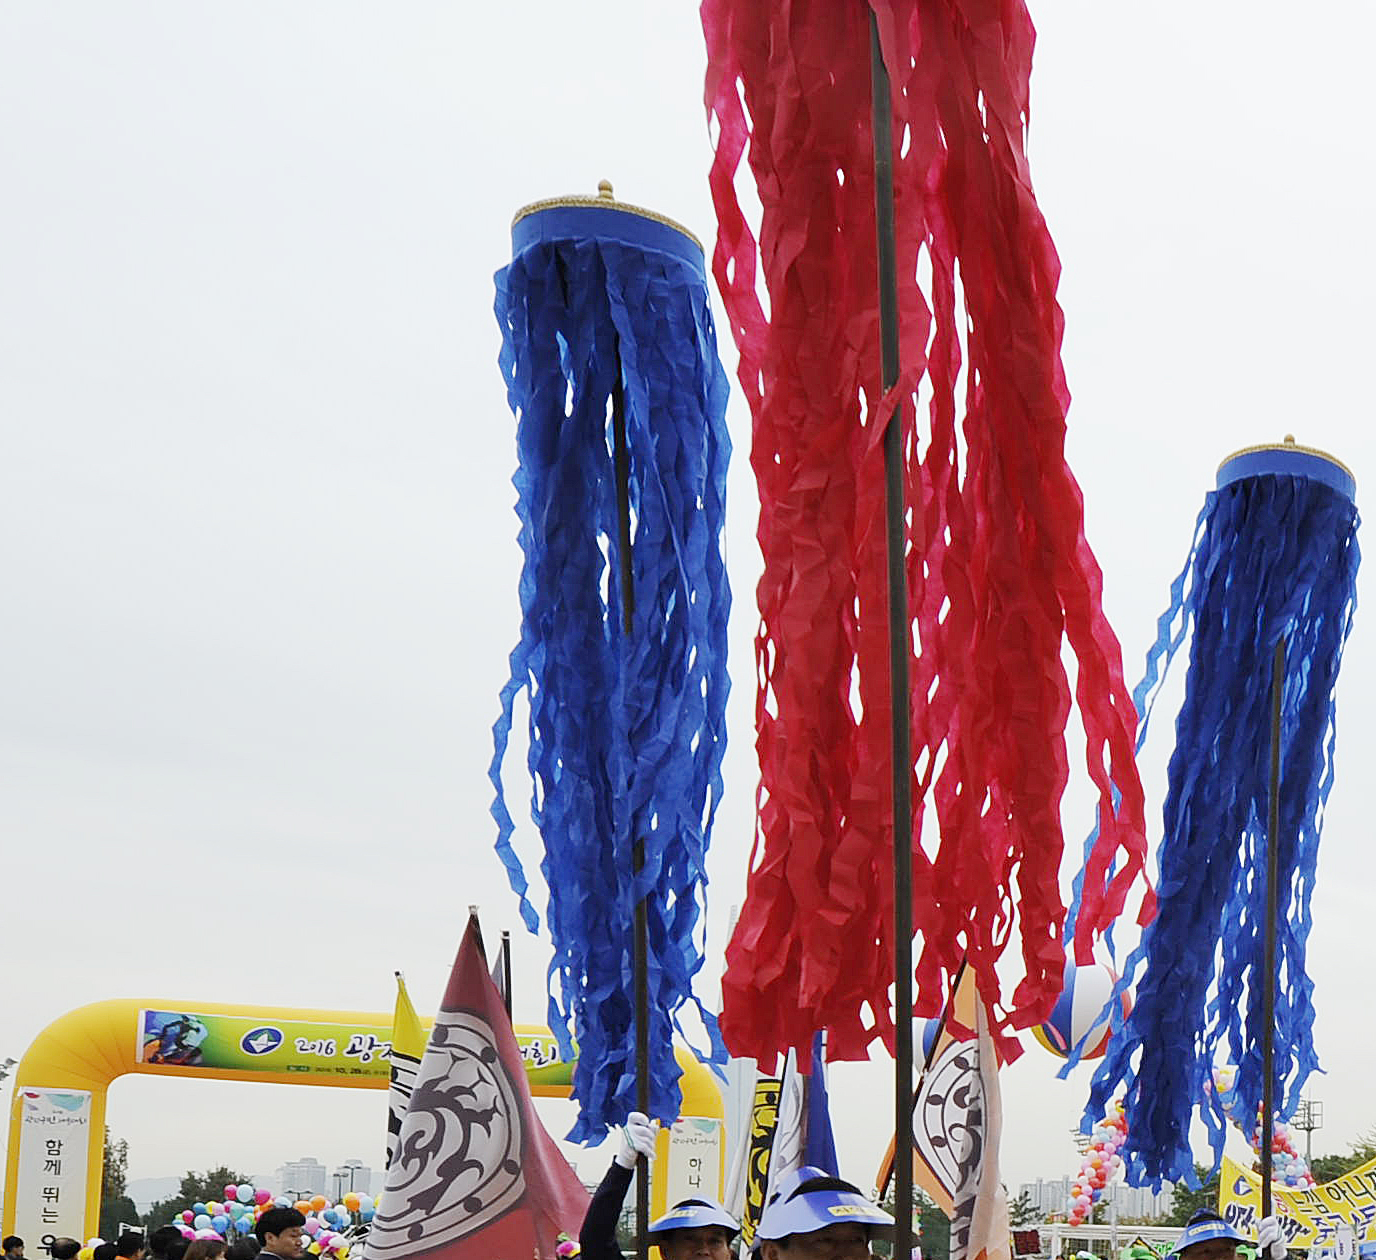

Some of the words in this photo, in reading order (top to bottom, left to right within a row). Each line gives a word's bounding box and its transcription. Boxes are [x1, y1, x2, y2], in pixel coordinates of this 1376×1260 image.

[299, 1039, 335, 1056] 2016
[43, 1139, 64, 1176] 함께
[41, 1187, 60, 1224] 뛰는
